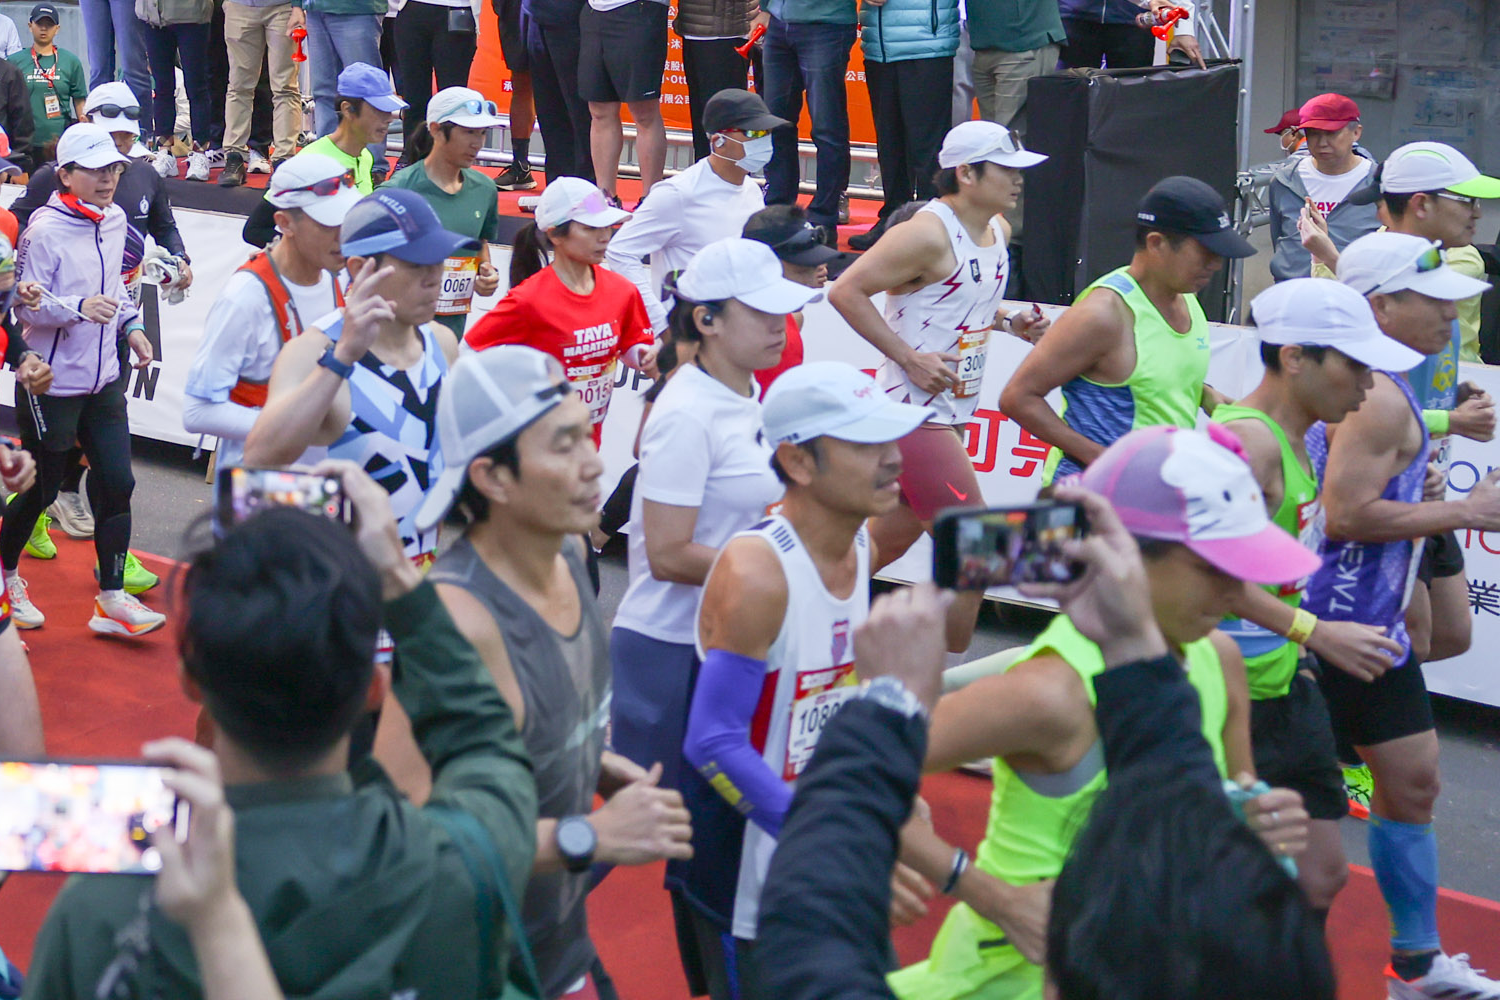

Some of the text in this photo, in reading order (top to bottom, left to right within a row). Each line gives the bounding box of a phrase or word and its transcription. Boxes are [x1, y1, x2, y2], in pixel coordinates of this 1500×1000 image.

[379, 194, 407, 215] WILD
[443, 278, 471, 293] 0067
[573, 322, 613, 345] TAYA
